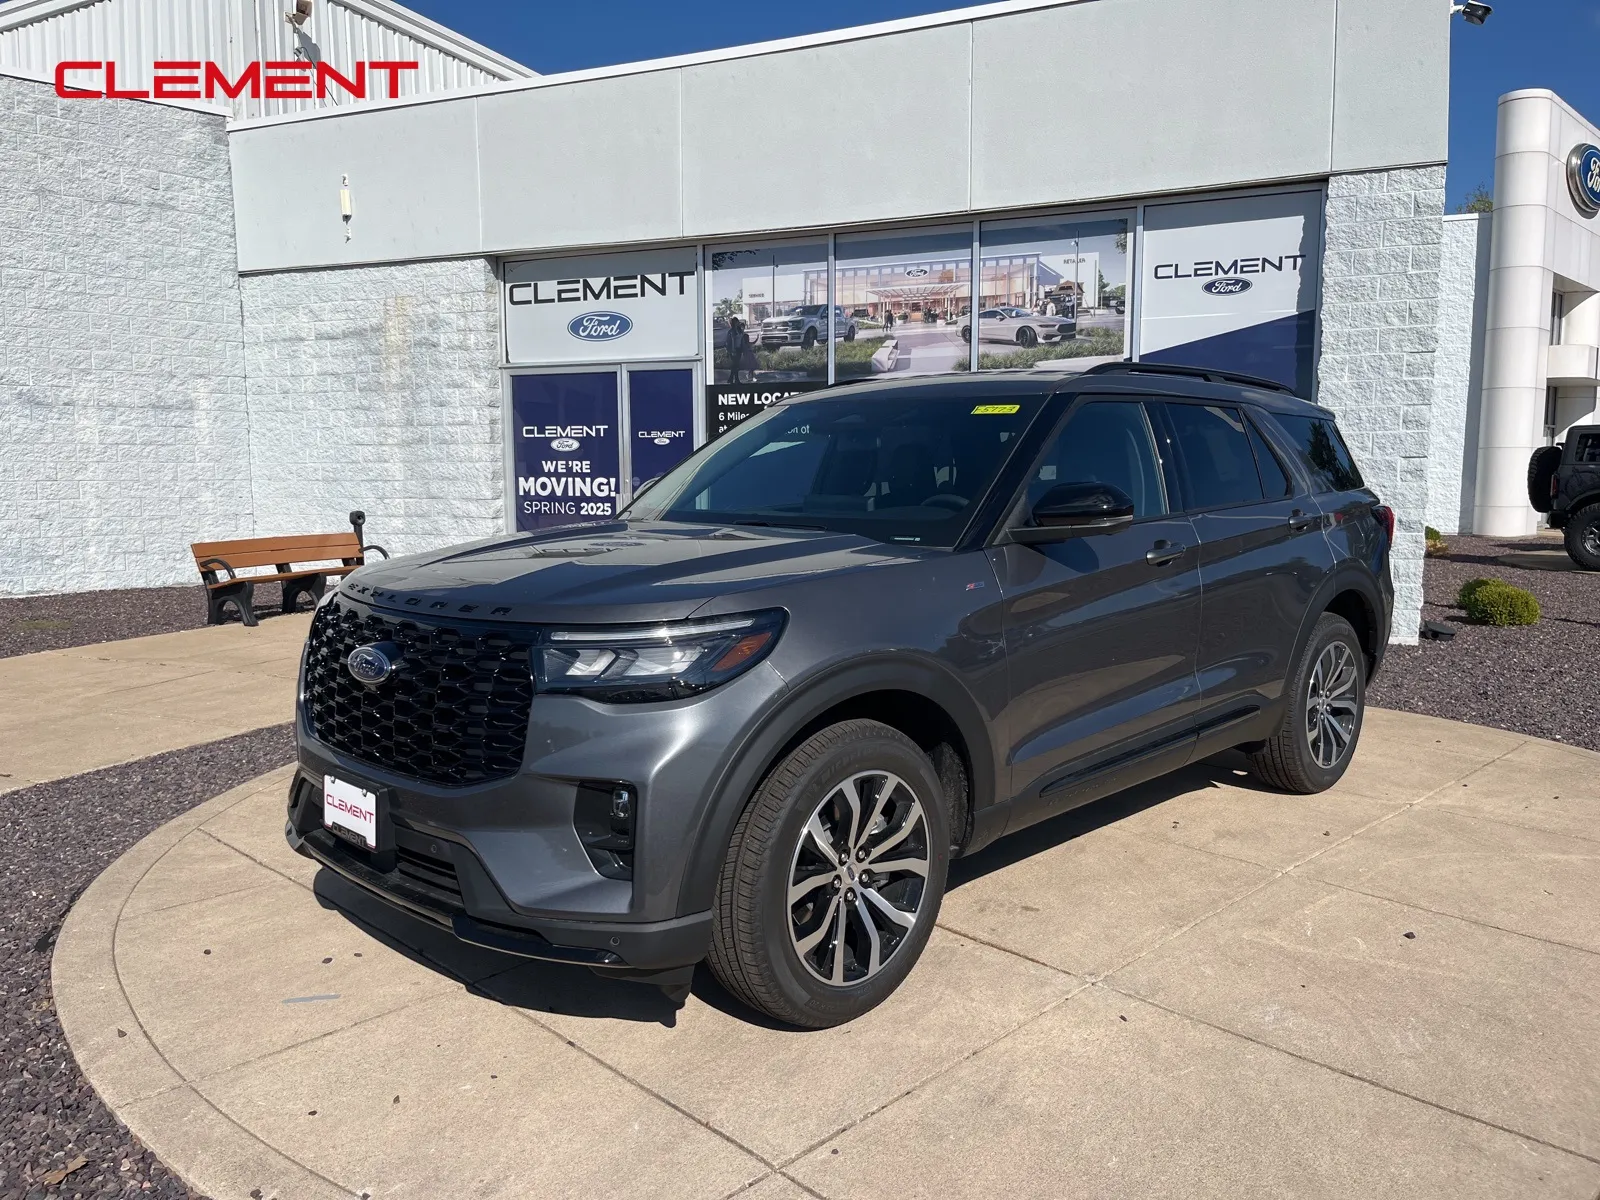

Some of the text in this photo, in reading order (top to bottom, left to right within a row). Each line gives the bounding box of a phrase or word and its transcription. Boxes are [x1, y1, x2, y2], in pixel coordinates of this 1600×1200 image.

[1587, 157, 1600, 193] Fo
[1063, 257, 1086, 265] RETAER
[1154, 254, 1306, 280] CLEMENT
[509, 271, 696, 306] CLEMENT
[1211, 280, 1242, 293] Ford
[579, 315, 620, 337] Ford
[718, 392, 803, 405] NEW LOC
[718, 411, 750, 421] 6 Mile
[522, 425, 608, 438] CLEMENT
[556, 440, 574, 449] Ford
[542, 461, 591, 473] WE'RE
[518, 477, 616, 497] MOVING!
[524, 501, 612, 516] SPRING 2025
[352, 653, 379, 676] Ford
[326, 793, 375, 824] CLEMENT
